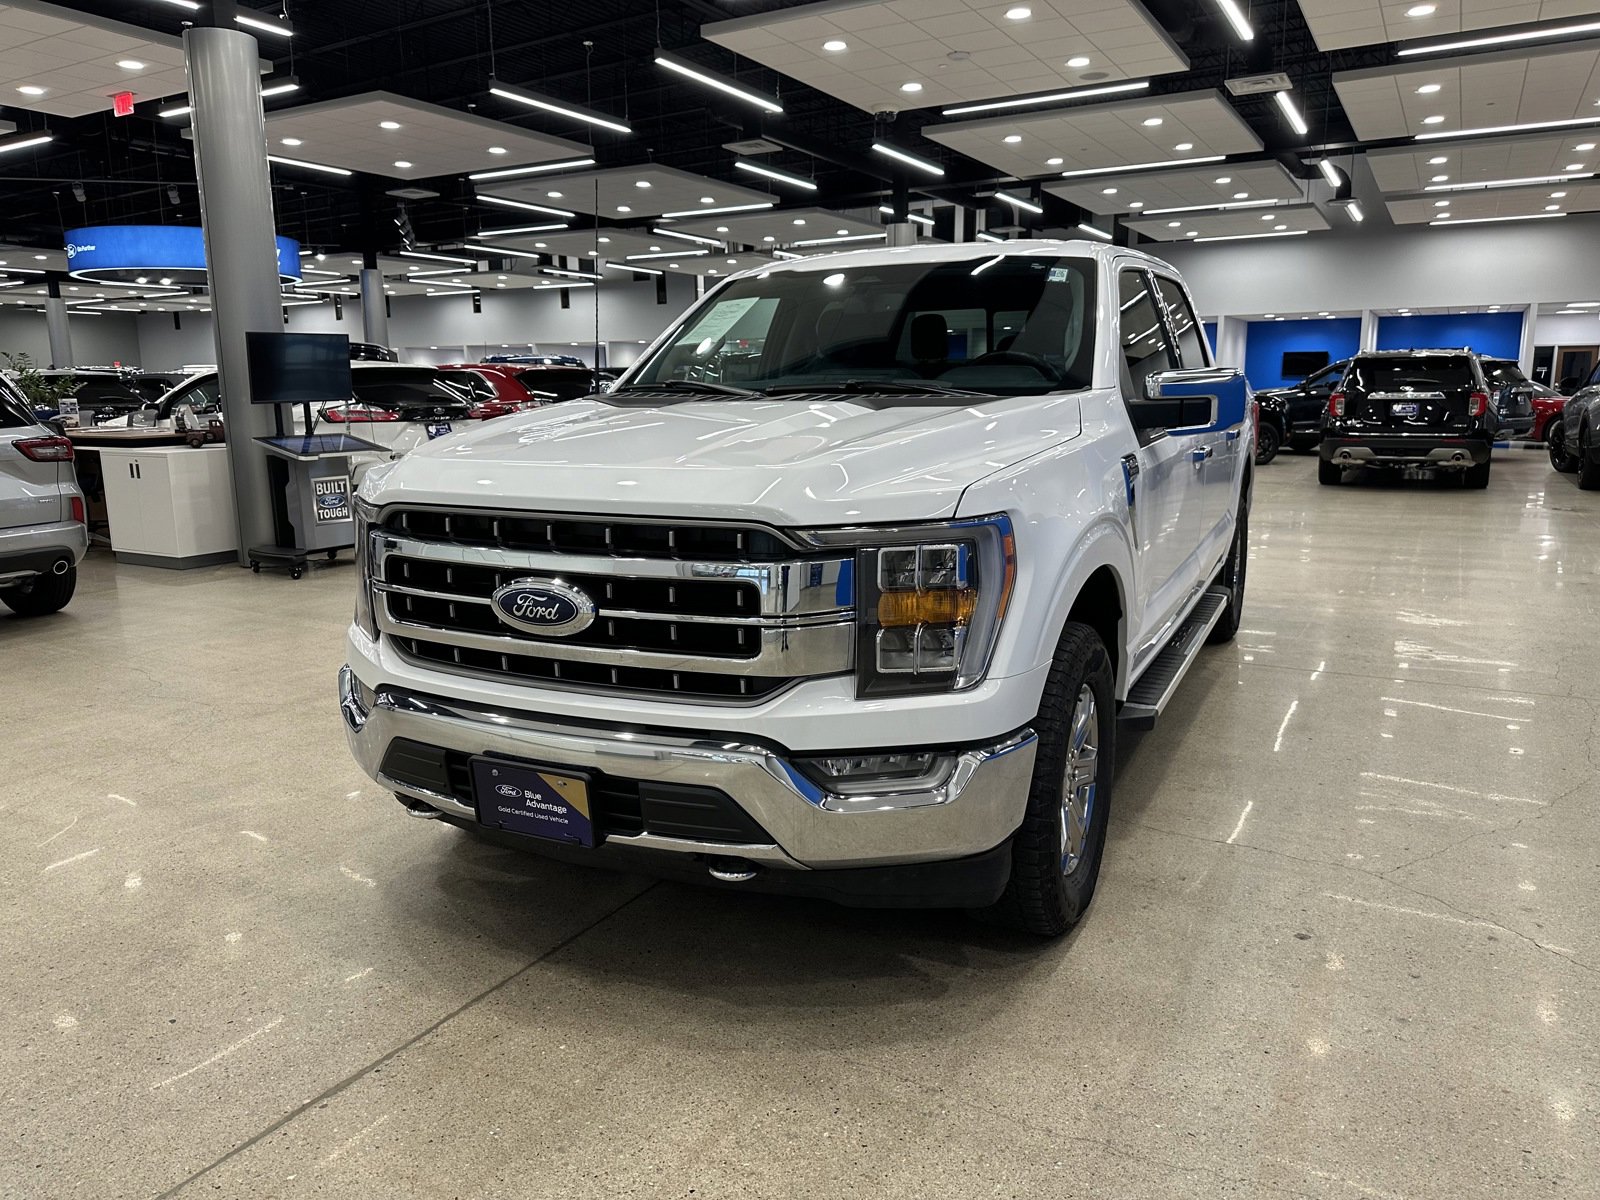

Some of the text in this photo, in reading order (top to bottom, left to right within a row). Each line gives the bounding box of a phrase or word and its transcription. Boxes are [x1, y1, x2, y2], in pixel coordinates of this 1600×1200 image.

[316, 481, 346, 495] BUILT
[324, 496, 340, 505] Ford
[318, 507, 349, 520] TOUGH
[512, 593, 560, 620] Ford
[500, 785, 517, 796] Ford
[524, 790, 542, 800] Blue
[526, 799, 568, 815] Advantage
[498, 805, 569, 825] Gold Certified Used Vehicle
